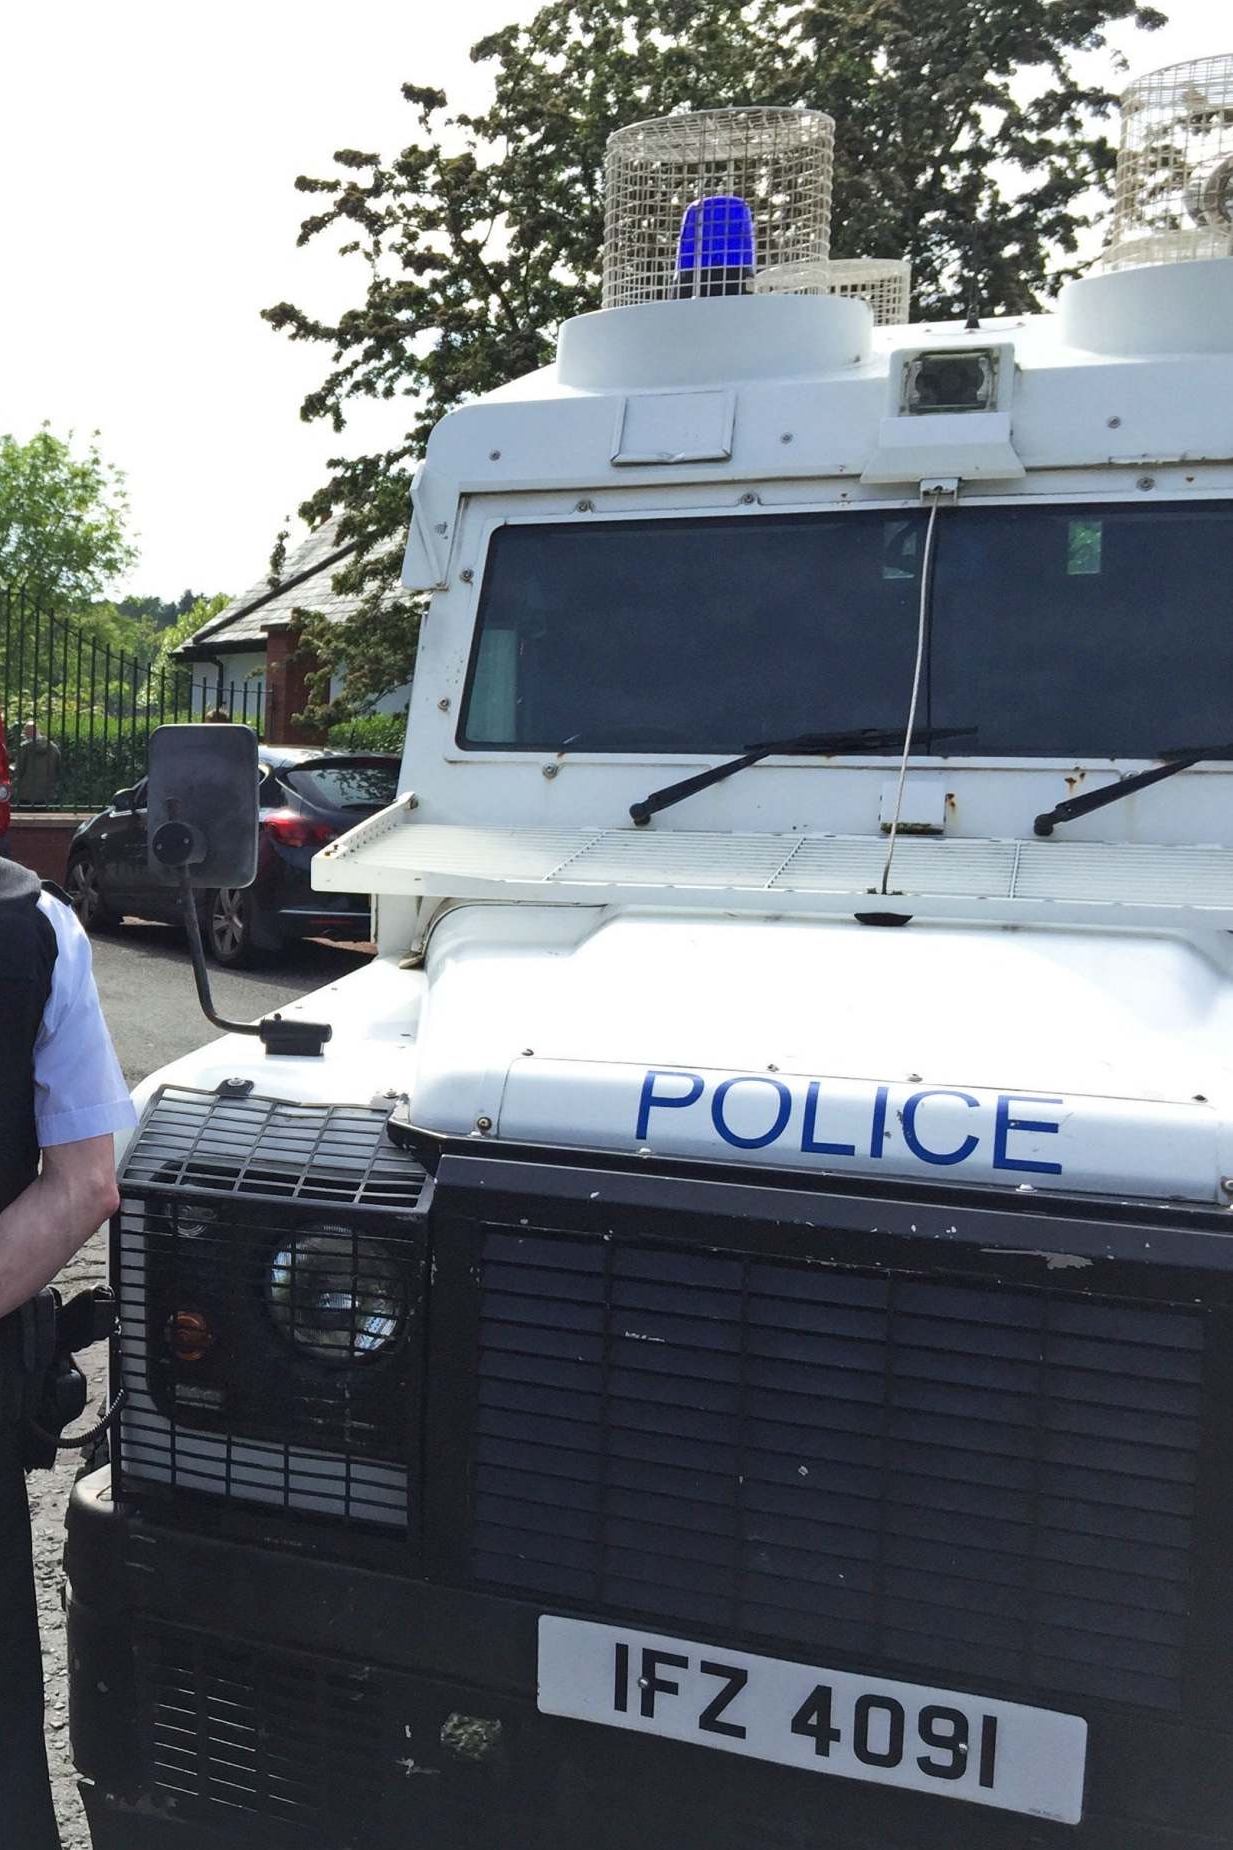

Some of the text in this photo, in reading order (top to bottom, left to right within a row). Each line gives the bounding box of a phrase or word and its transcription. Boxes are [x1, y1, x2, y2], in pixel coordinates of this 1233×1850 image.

[635, 1070, 1064, 1175] POLICE
[614, 1642, 998, 1789] IFZ 4091
